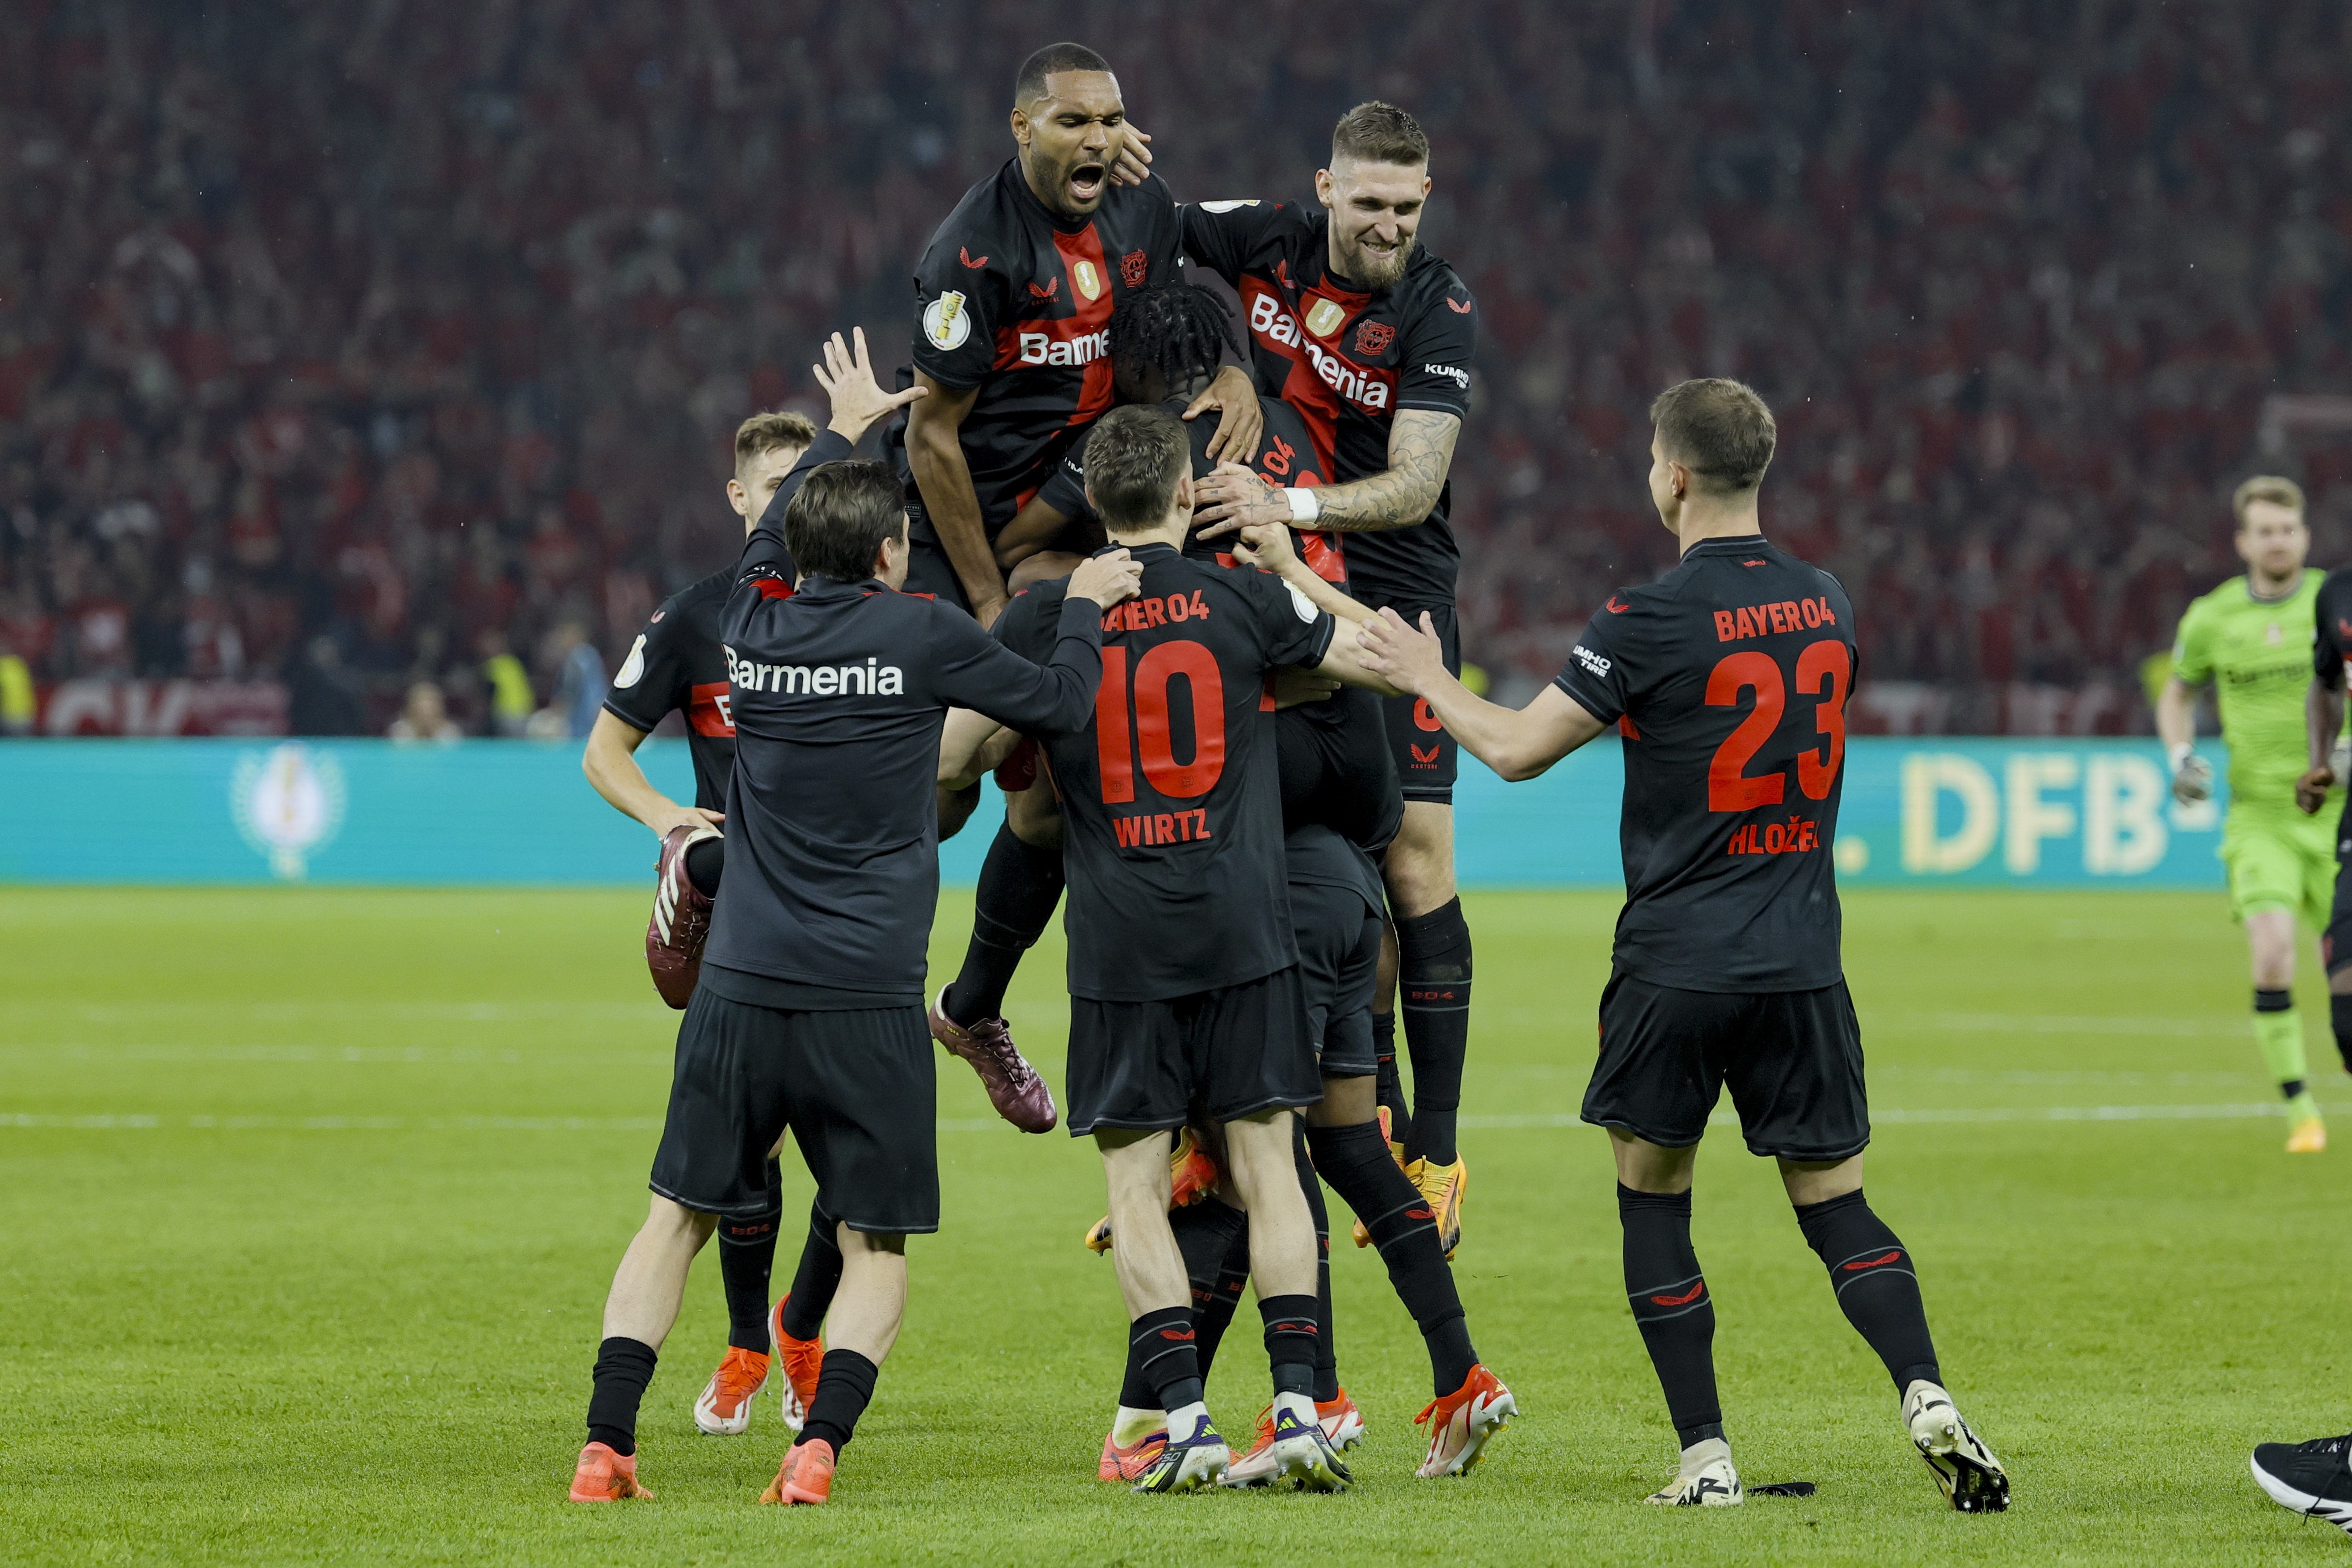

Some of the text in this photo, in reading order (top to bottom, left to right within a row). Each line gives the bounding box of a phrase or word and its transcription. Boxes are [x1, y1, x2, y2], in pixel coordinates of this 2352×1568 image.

[1020, 328, 1110, 366] Barme
[1425, 363, 1469, 384] KUMHO
[1100, 590, 1210, 631] AYER04
[723, 643, 904, 695] Barmenia
[1573, 645, 1612, 670] UMHO
[1581, 658, 1608, 677] TIRE
[1096, 640, 1225, 804] 10
[1705, 640, 1850, 812] 23
[1113, 808, 1211, 847] WIRTZ
